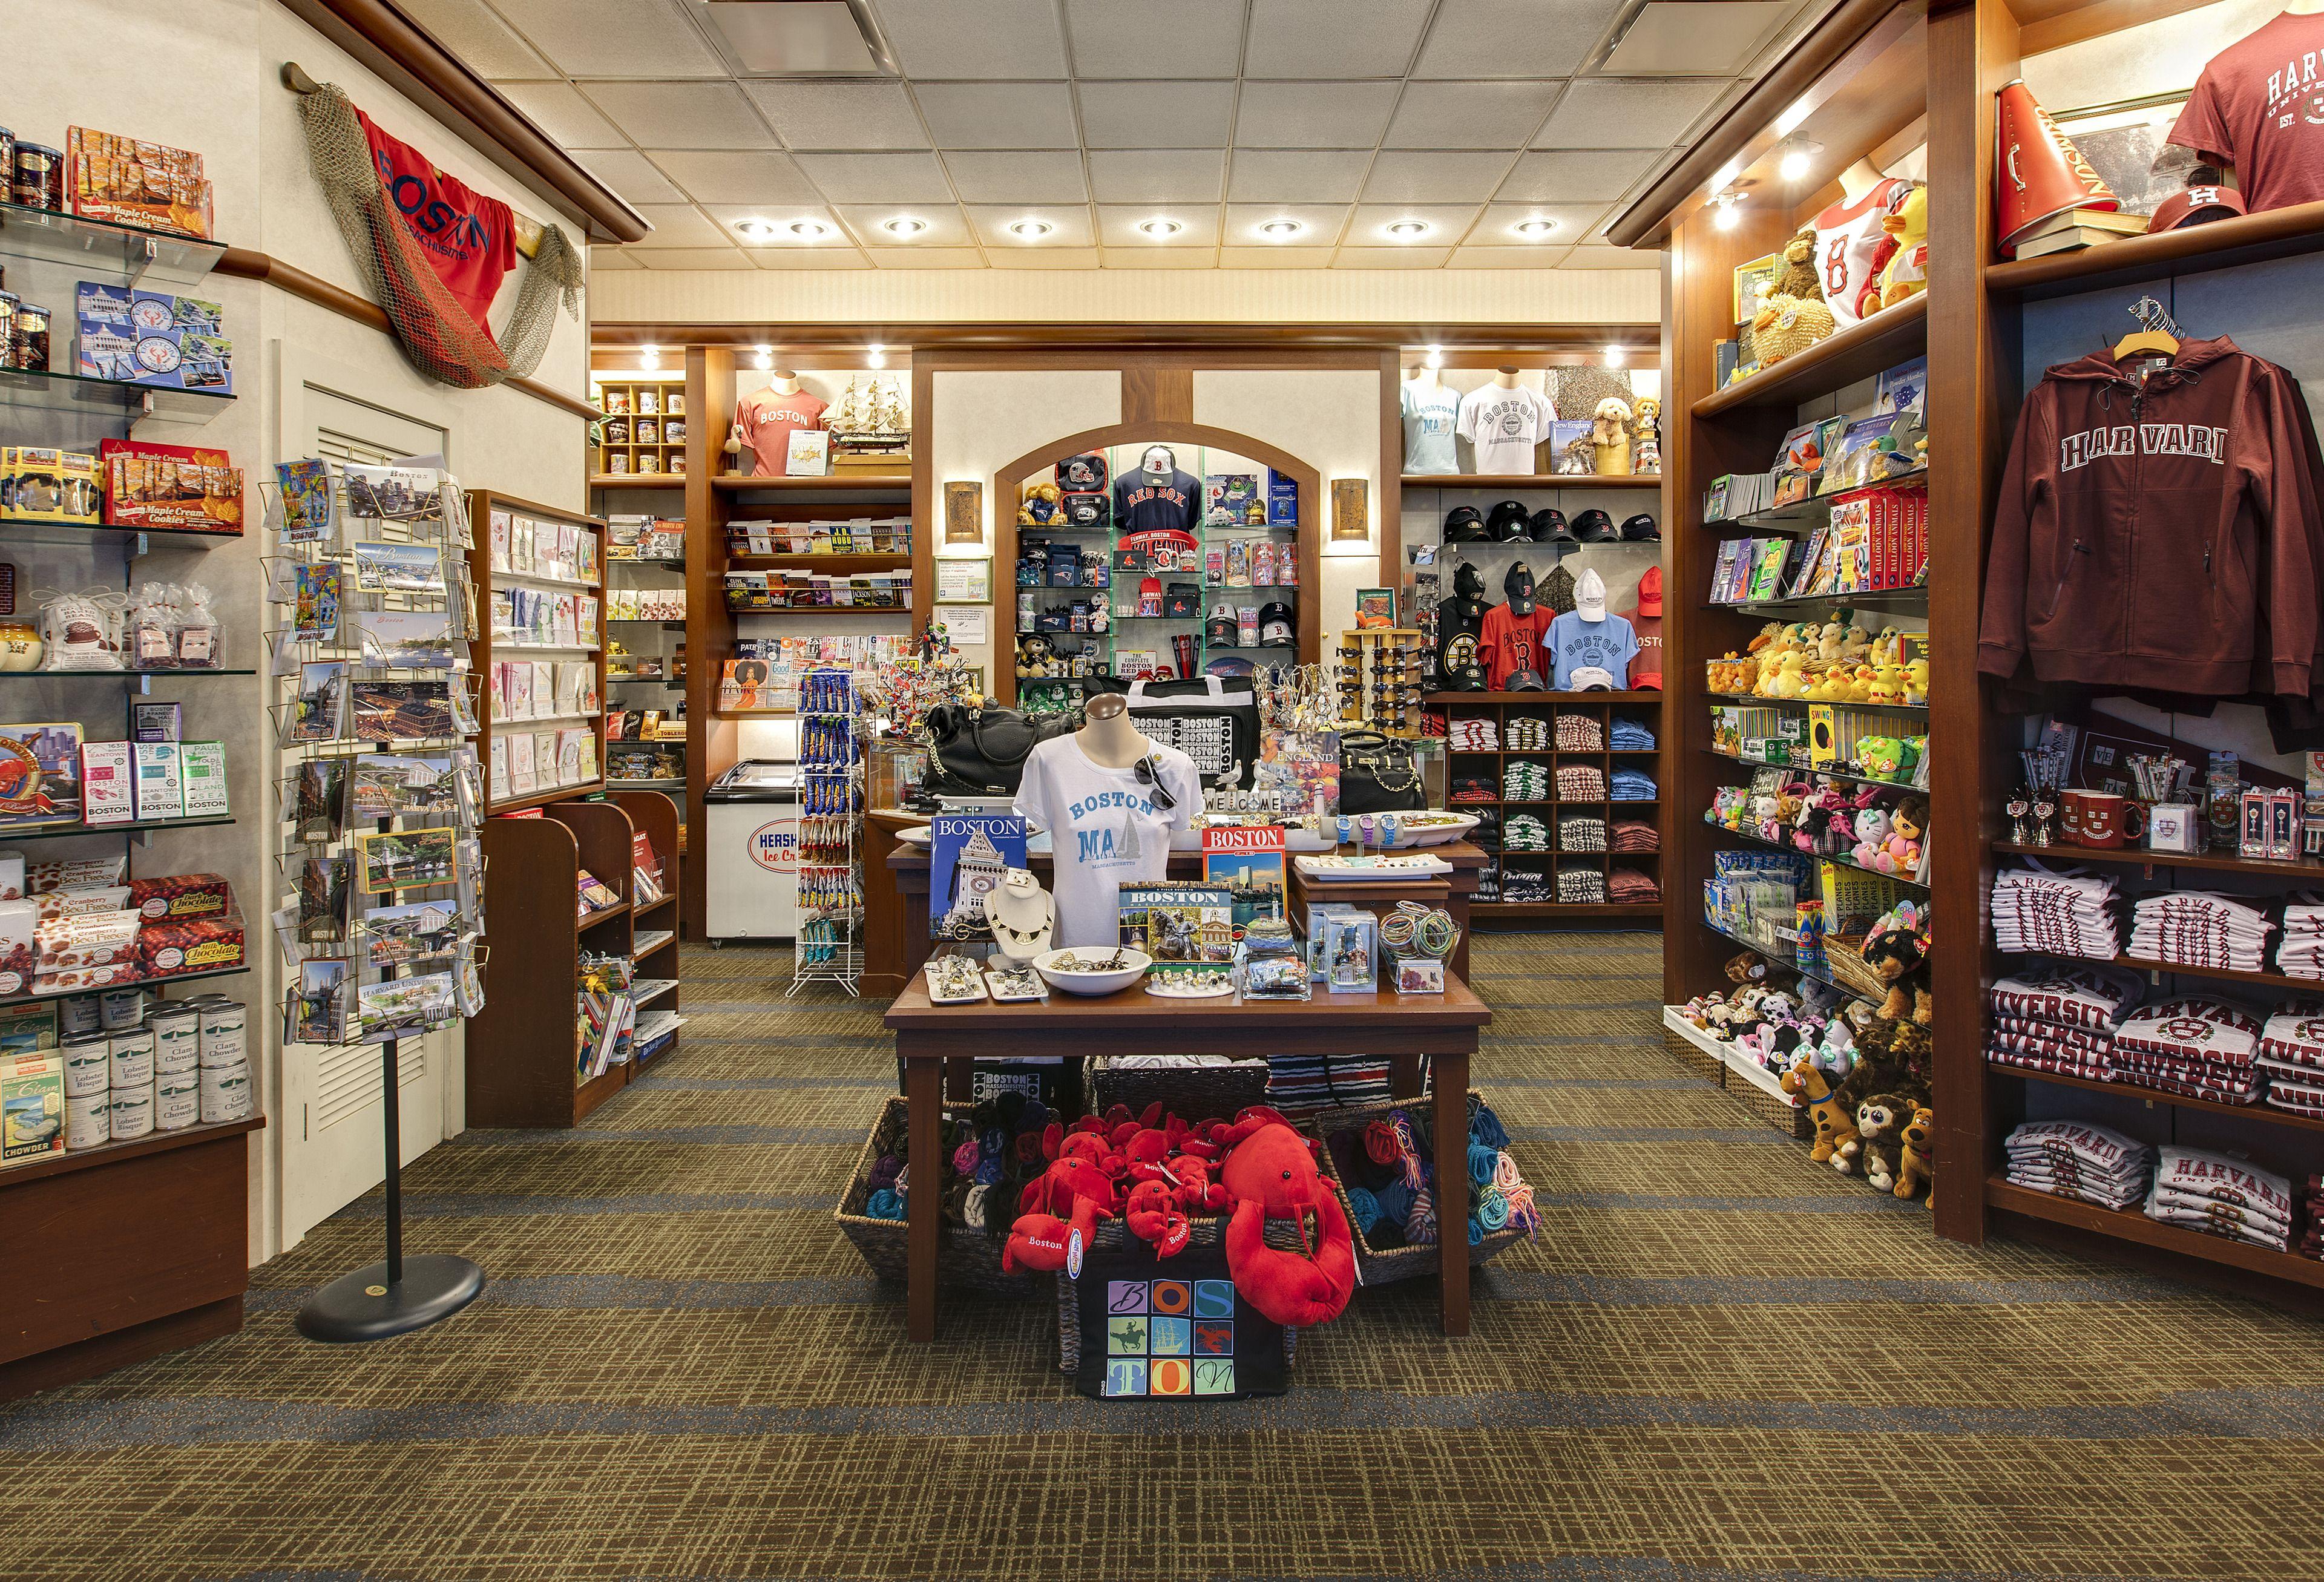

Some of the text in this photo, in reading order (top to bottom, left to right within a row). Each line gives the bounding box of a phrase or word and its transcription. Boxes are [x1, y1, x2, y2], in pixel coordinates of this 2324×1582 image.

[2279, 113, 2296, 128] EST.
[2034, 105, 2110, 196] CRIMSON
[2188, 186, 2220, 207] H
[111, 205, 171, 224] Maple Cream
[114, 214, 151, 228] Cookies
[1889, 378, 1905, 388] Powder
[1906, 371, 1925, 382] Monkey
[1419, 405, 1454, 415] BOSTON
[1483, 401, 1536, 424] BOSTON
[761, 410, 807, 426] BOSTON
[163, 455, 189, 464] Cream
[1154, 461, 1161, 470] B
[1128, 487, 1154, 507] RED
[1158, 487, 1186, 507] SOX
[145, 505, 205, 517] Maple Cream
[149, 514, 185, 524] Cookies
[376, 546, 423, 561] Boston
[853, 590, 871, 599] JACKSON
[1218, 606, 1225, 614] B
[1275, 626, 1282, 635] B
[1503, 628, 1540, 648] BOSTON
[1565, 635, 1621, 657] BOSTON
[1455, 643, 1472, 666] B
[773, 663, 789, 673] Good
[1811, 709, 1832, 721] SWING!
[1133, 718, 1170, 727] BOSTON
[1183, 718, 1219, 728] BOSTON
[1183, 733, 1219, 741] BOSTON
[1183, 747, 1219, 756] BOSTON
[1221, 718, 1230, 774] BOSTON
[1, 739, 40, 772] OBSTERS
[1756, 773, 1773, 786] Super
[1751, 780, 1774, 795] Scratch
[89, 806, 130, 815] BOSTON
[1069, 792, 1155, 820] BOSTON
[939, 819, 1022, 836] BOSTON
[634, 833, 646, 842] AGAT
[760, 834, 796, 848] HERSH
[1210, 830, 1278, 847] BOSTON
[2086, 831, 2109, 839] HARVARD
[1078, 829, 1117, 863] MA
[764, 849, 780, 861] Ice
[2000, 877, 2083, 899] ARVARD
[1131, 893, 1219, 903] BOSTON
[1882, 881, 1891, 910] PLANES
[171, 896, 222, 908] Chocolate
[97, 932, 130, 940] FROGS
[186, 945, 238, 959] Chocolate
[363, 978, 448, 998] HARVARD UNIVERSITY
[111, 1006, 137, 1016] Lobster
[1991, 988, 2112, 1031] NIVERSIT
[112, 1013, 137, 1022] Bisque
[172, 1046, 192, 1055] Clam
[209, 1046, 241, 1057] Chowder
[215, 1042, 235, 1050] Clam
[165, 1052, 198, 1063] Chowder
[123, 1064, 149, 1074] Lobster
[124, 1070, 149, 1080] Bisque
[76, 1072, 104, 1082] Lobster
[77, 1078, 103, 1088] Bisque
[986, 1074, 1026, 1084] BOSTON
[19, 1081, 59, 1097] Clam
[171, 1102, 191, 1111] Clam
[164, 1108, 197, 1118] Chowder
[116, 1116, 144, 1125] Lobster
[117, 1122, 143, 1131] Bisque
[5, 1143, 48, 1157] CHOWDER
[2175, 1158, 2291, 1213] HARVARD
[1168, 1222, 1186, 1245] Boston
[1028, 1236, 1063, 1249] Boston
